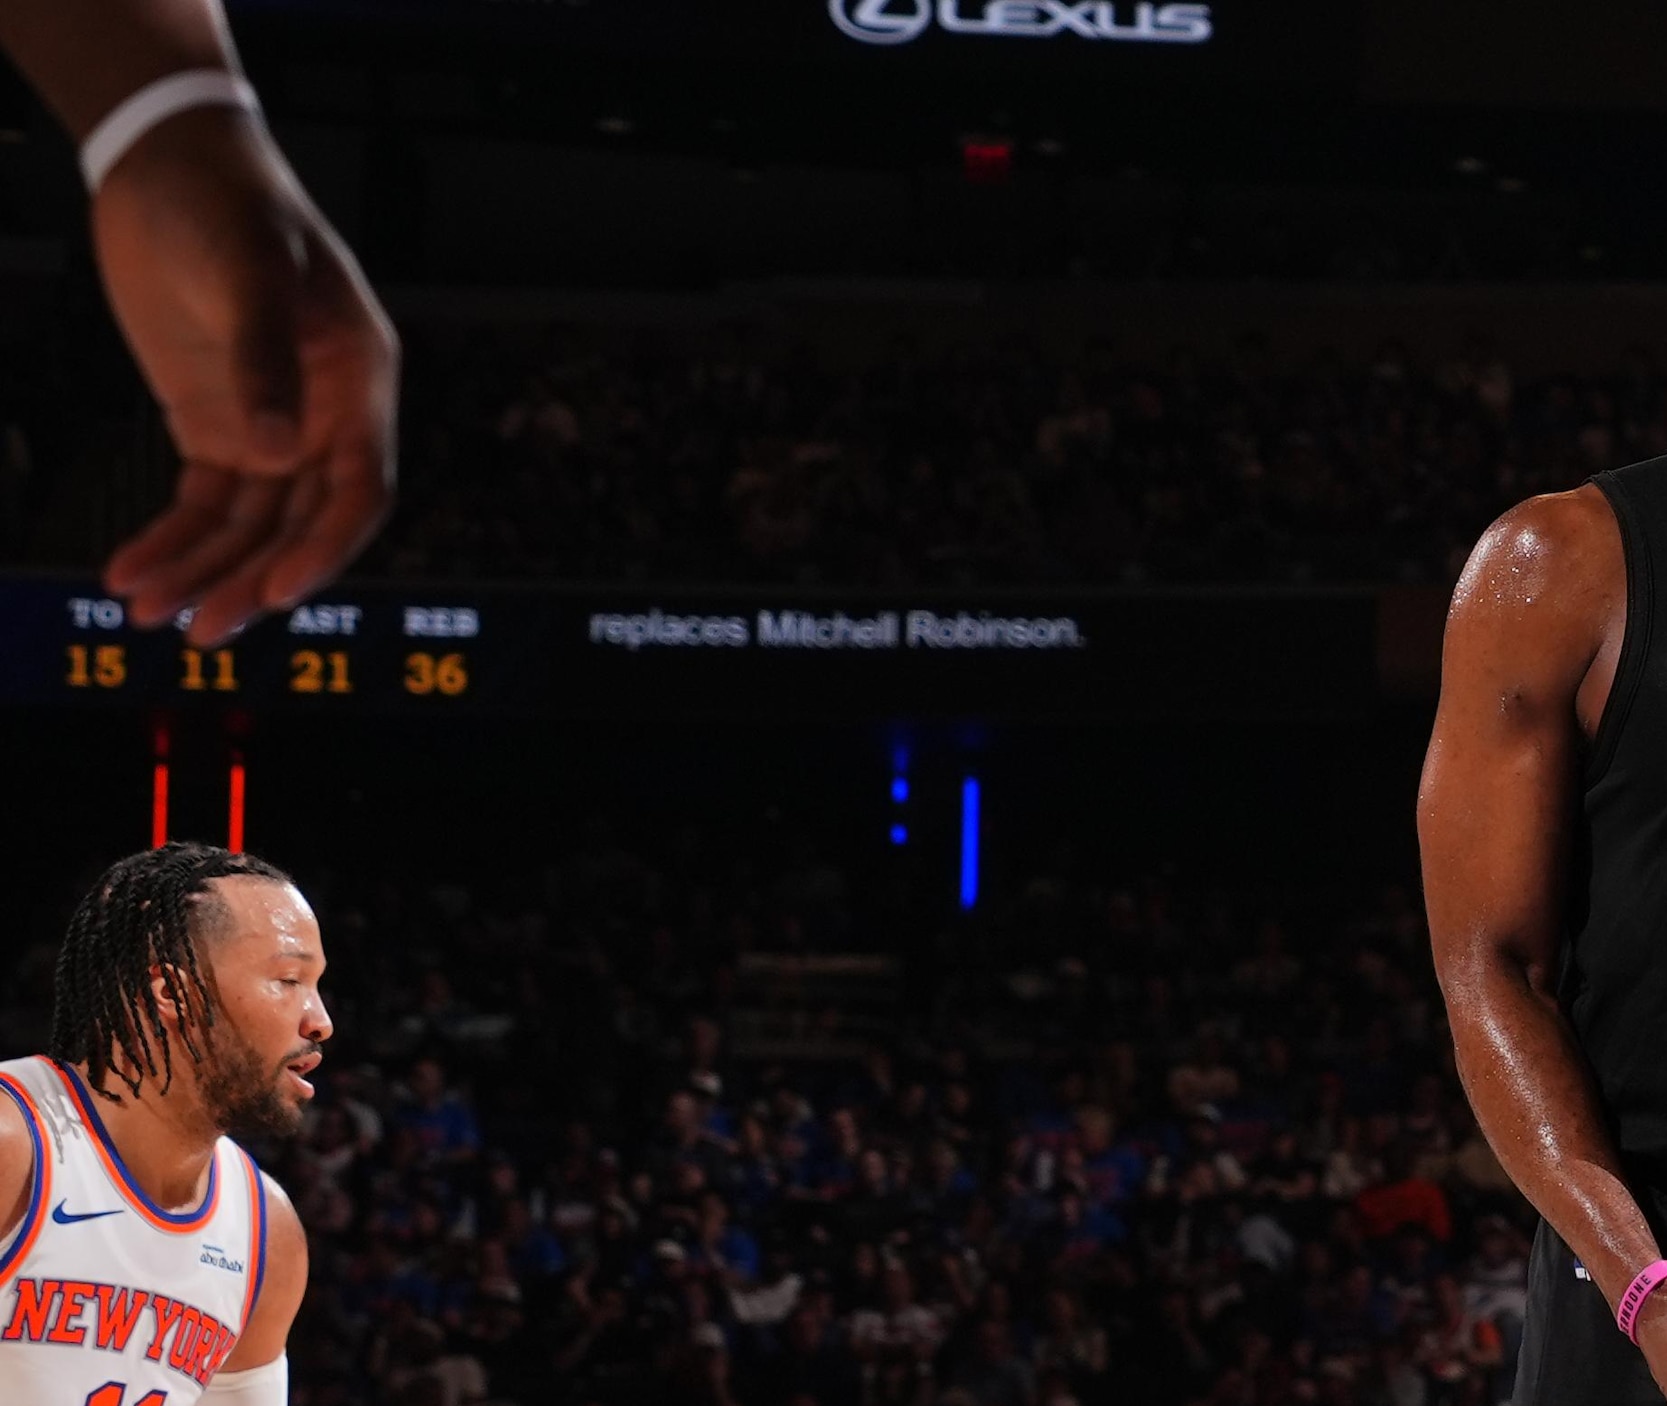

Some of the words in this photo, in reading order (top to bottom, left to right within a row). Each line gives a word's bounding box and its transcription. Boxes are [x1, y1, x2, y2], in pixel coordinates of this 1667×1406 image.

[937, 0, 1213, 43] LEXUS
[288, 604, 362, 636] AST
[403, 606, 480, 638] REB
[590, 611, 748, 651] replaces
[756, 609, 899, 648] Mitchell
[905, 608, 1087, 648] Robinson.
[67, 645, 128, 689] 15
[180, 648, 239, 691] 11
[290, 650, 353, 693] 21
[403, 651, 469, 695] 36
[2, 1278, 148, 1351] NEW
[145, 1294, 239, 1391] YORK
